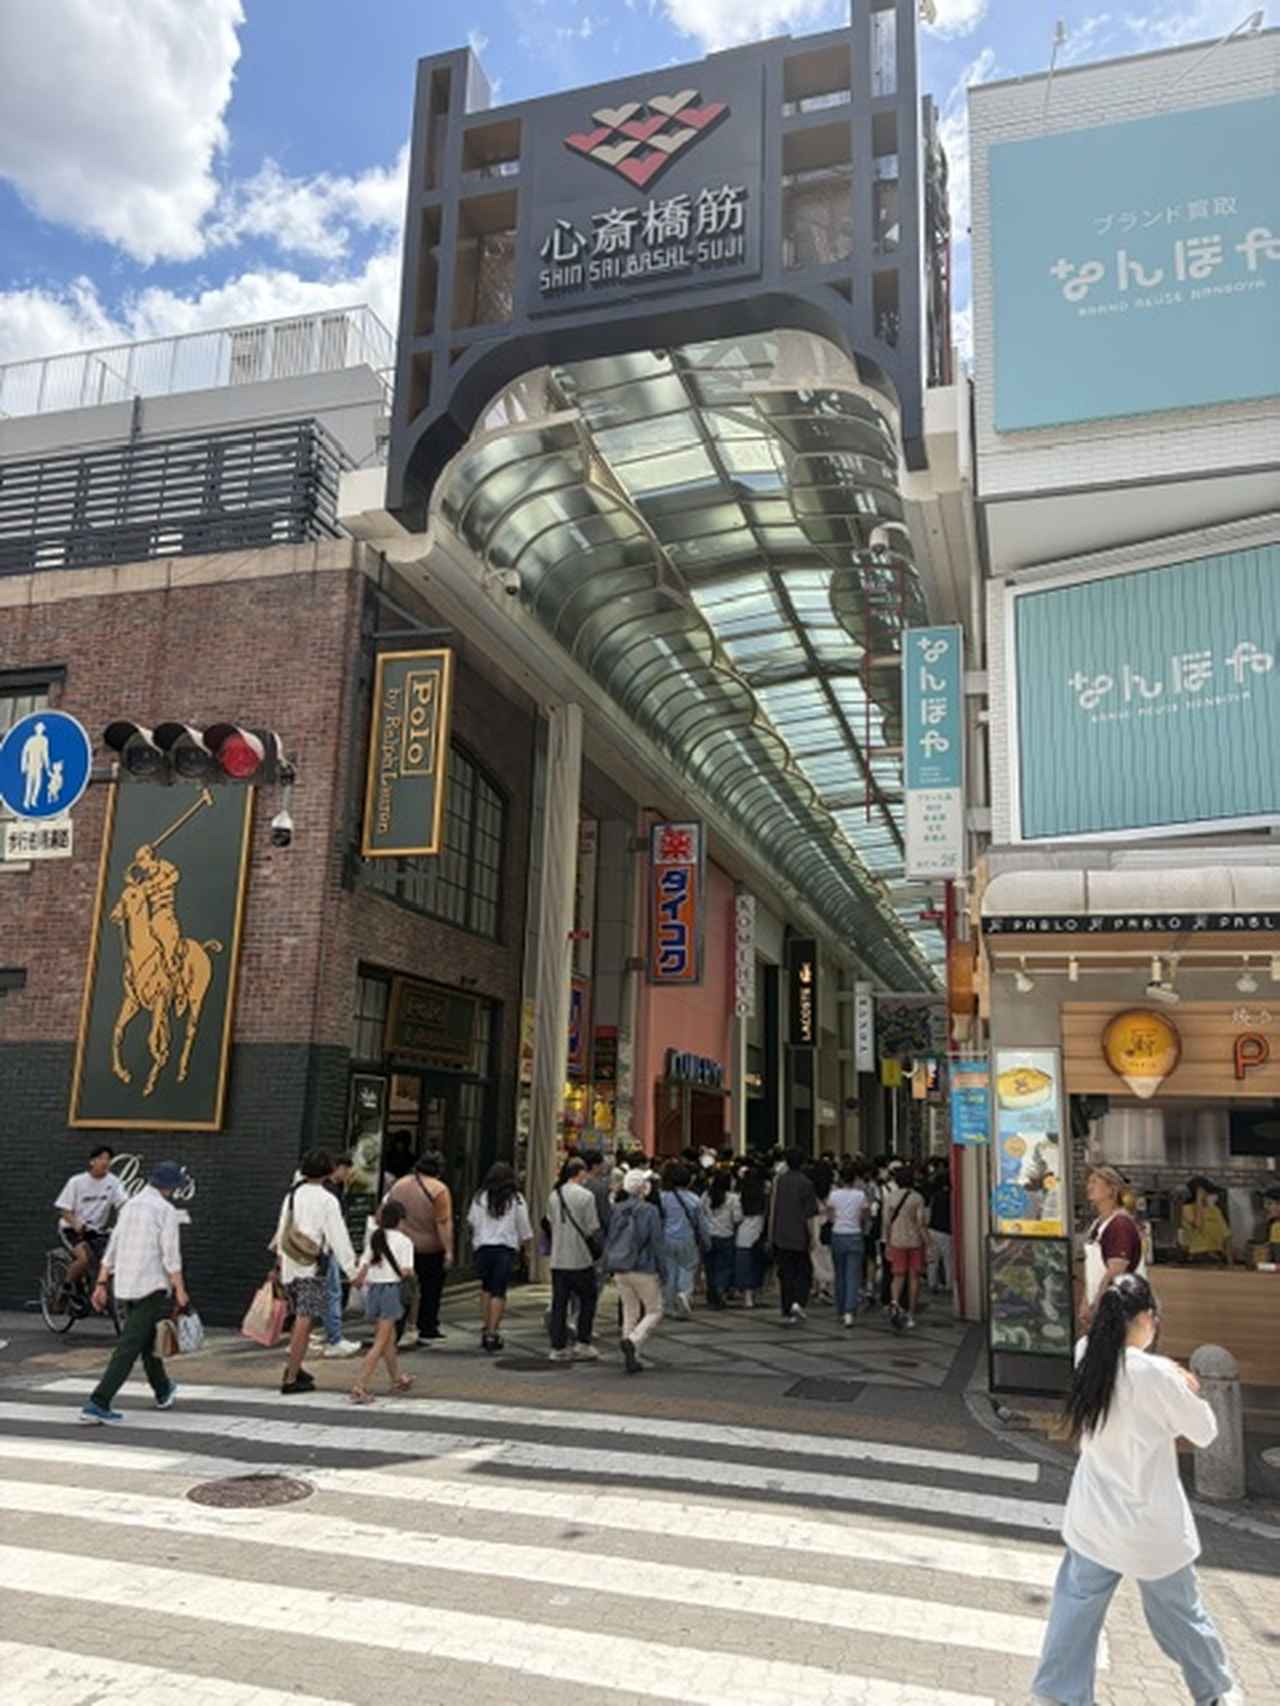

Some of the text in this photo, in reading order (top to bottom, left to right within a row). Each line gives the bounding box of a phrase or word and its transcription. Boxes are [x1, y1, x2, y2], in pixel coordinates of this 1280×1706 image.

[541, 184, 747, 261] 心斎橋筋
[1094, 196, 1238, 235] ブランド買取
[384, 687, 401, 710] by
[916, 636, 951, 760] なんぼや
[1067, 641, 1274, 709] なんぼや
[382, 715, 402, 768] Ralph
[406, 680, 434, 764] Polo
[1013, 918, 1079, 932] PABLO
[1113, 916, 1182, 931] PABLO
